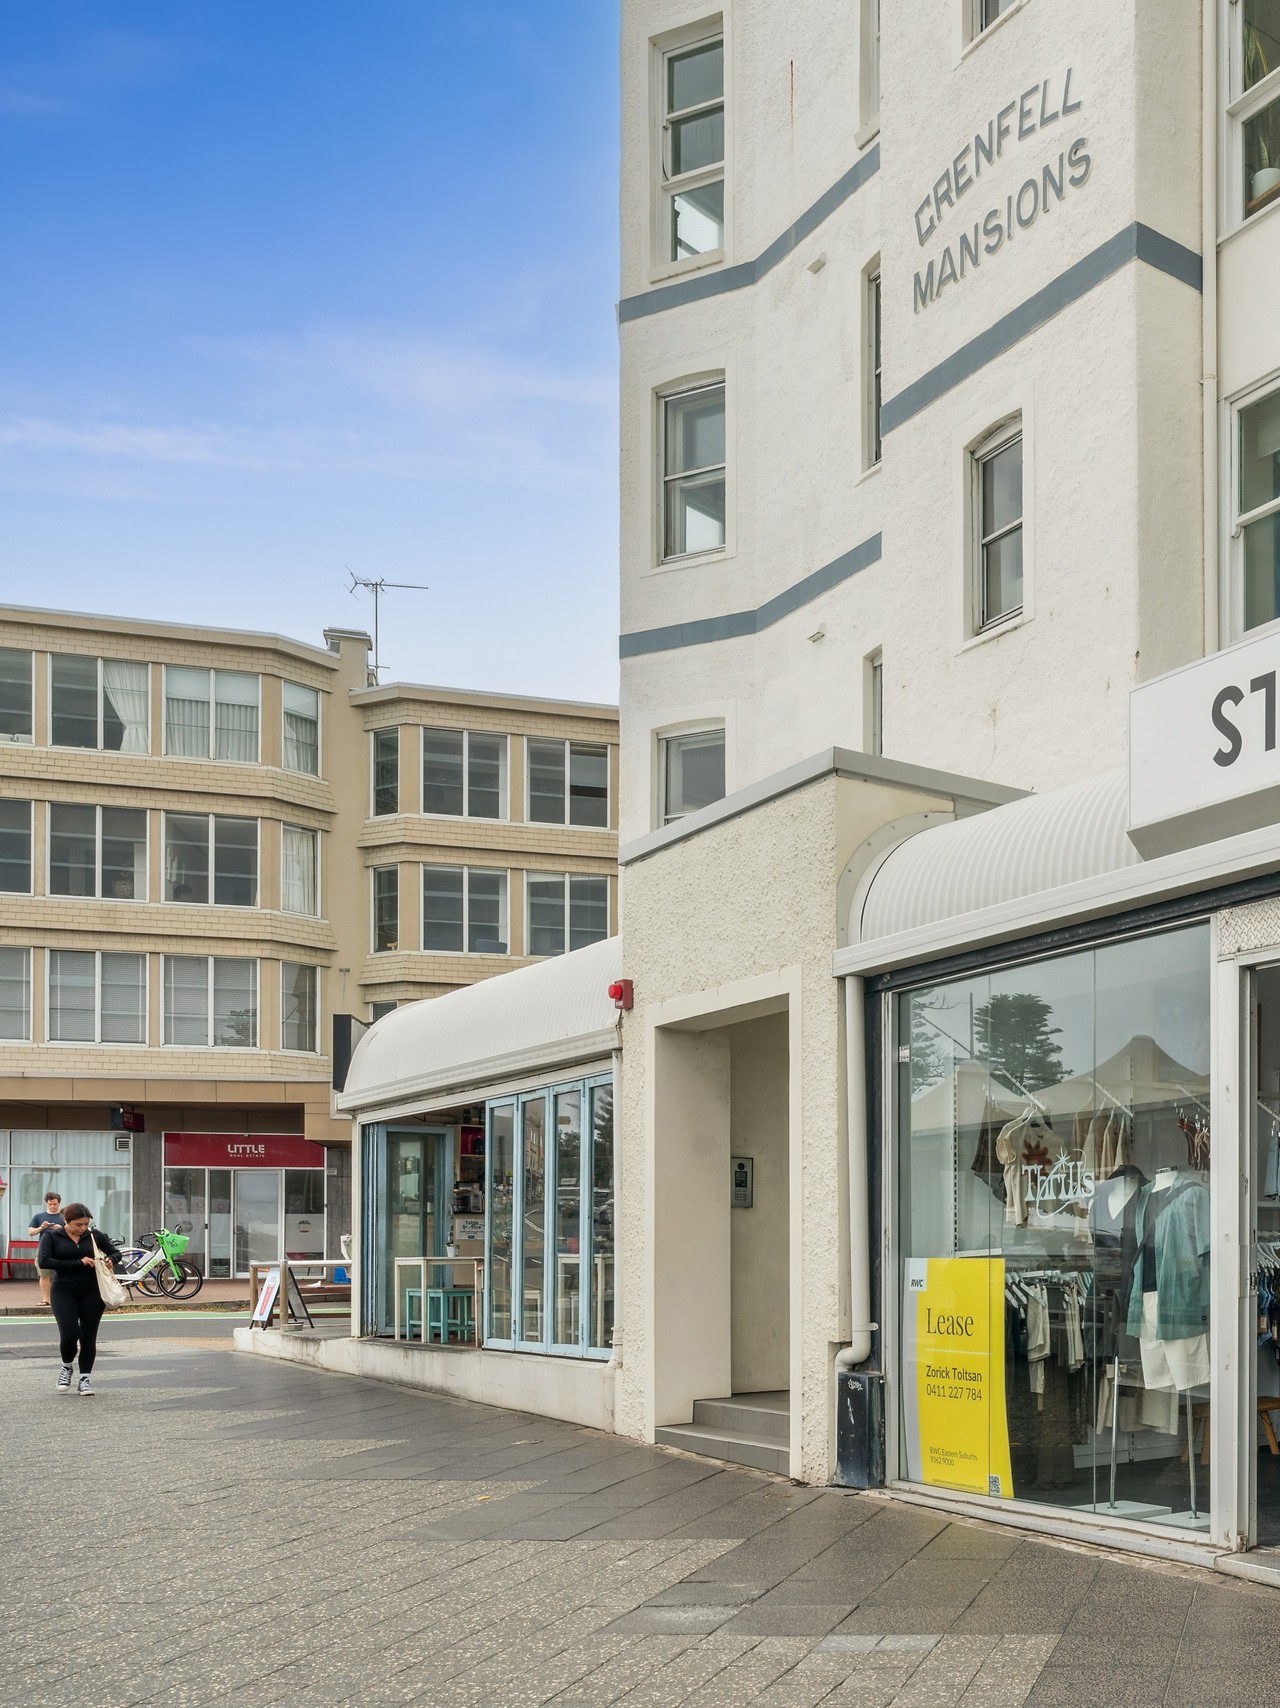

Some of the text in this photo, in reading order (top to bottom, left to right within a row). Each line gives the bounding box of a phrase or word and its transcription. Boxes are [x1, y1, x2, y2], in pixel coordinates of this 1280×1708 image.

[914, 67, 1082, 247] GRENFELL
[913, 137, 1092, 315] MANSIONS
[227, 1144, 265, 1154] LITTLE
[910, 1279, 924, 1288] RWC
[926, 1307, 975, 1337] Lease
[926, 1365, 983, 1383] Zorick Toltsan
[926, 1384, 983, 1402] 0411 227 784
[929, 1446, 941, 1456] RWC
[941, 1449, 959, 1459] Eastern
